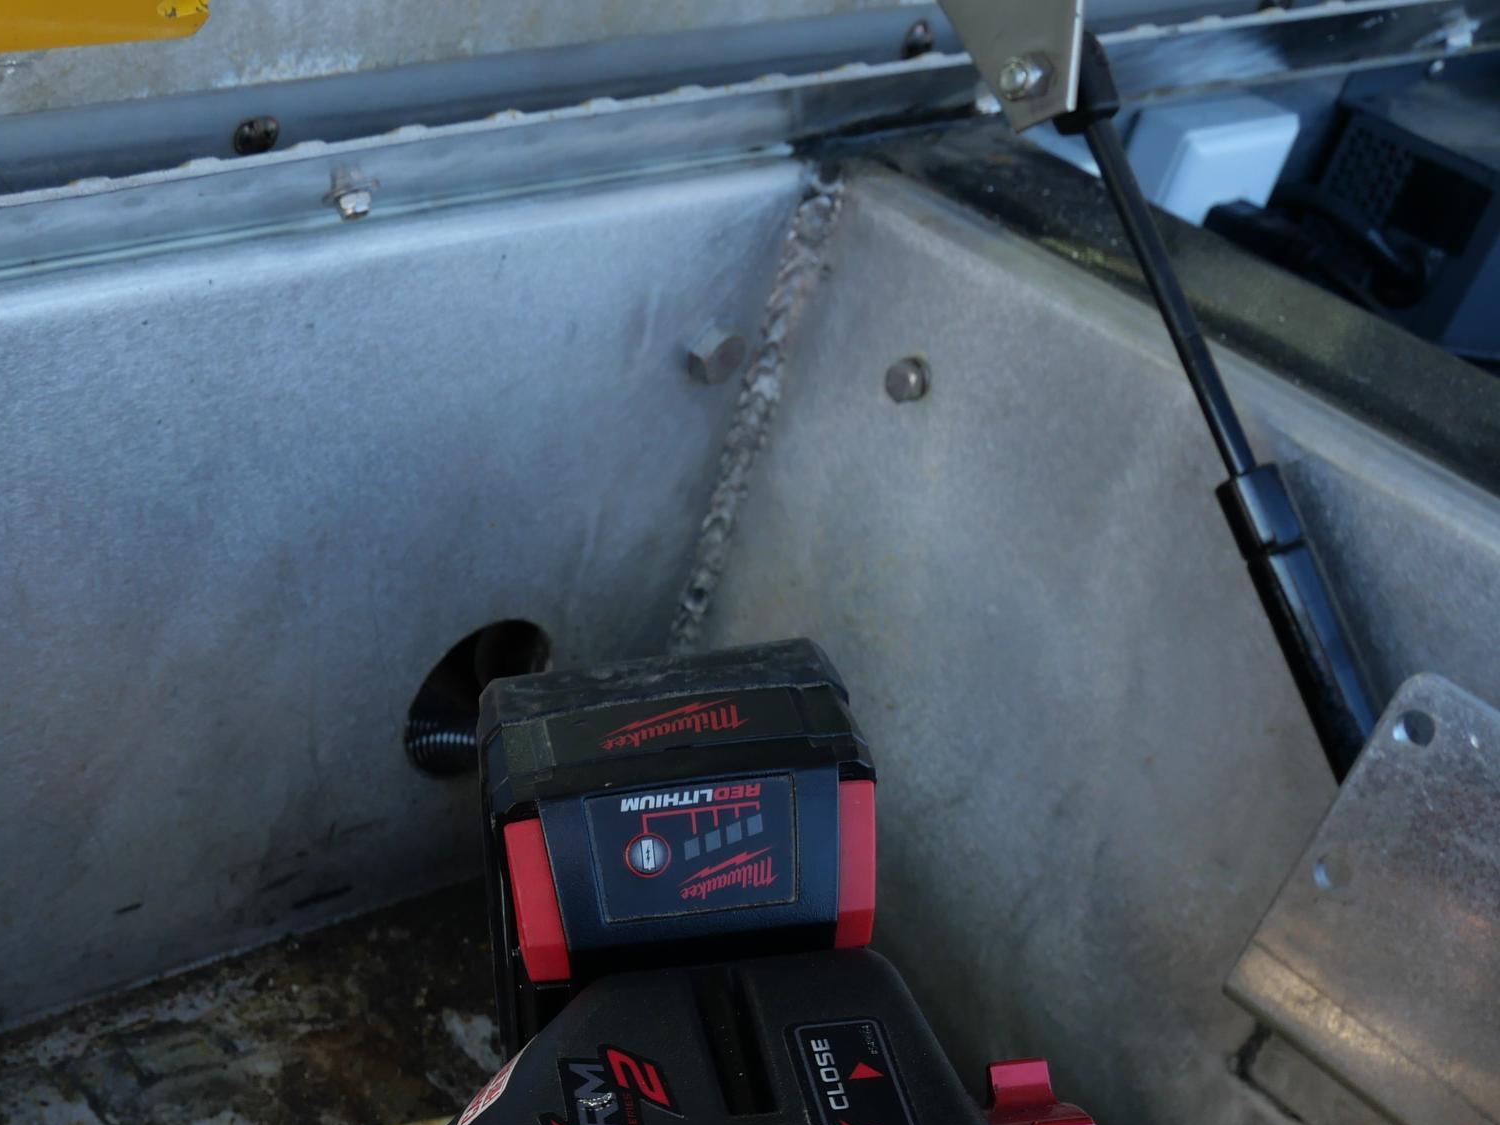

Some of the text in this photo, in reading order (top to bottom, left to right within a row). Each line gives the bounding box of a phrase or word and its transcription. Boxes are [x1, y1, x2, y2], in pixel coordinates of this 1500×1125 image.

[600, 704, 750, 751] Milwaukee
[620, 783, 761, 813] REDLITHIUM
[680, 855, 780, 901] Milwaukee
[607, 1049, 672, 1107] 2
[811, 1038, 850, 1111] CLOSE
